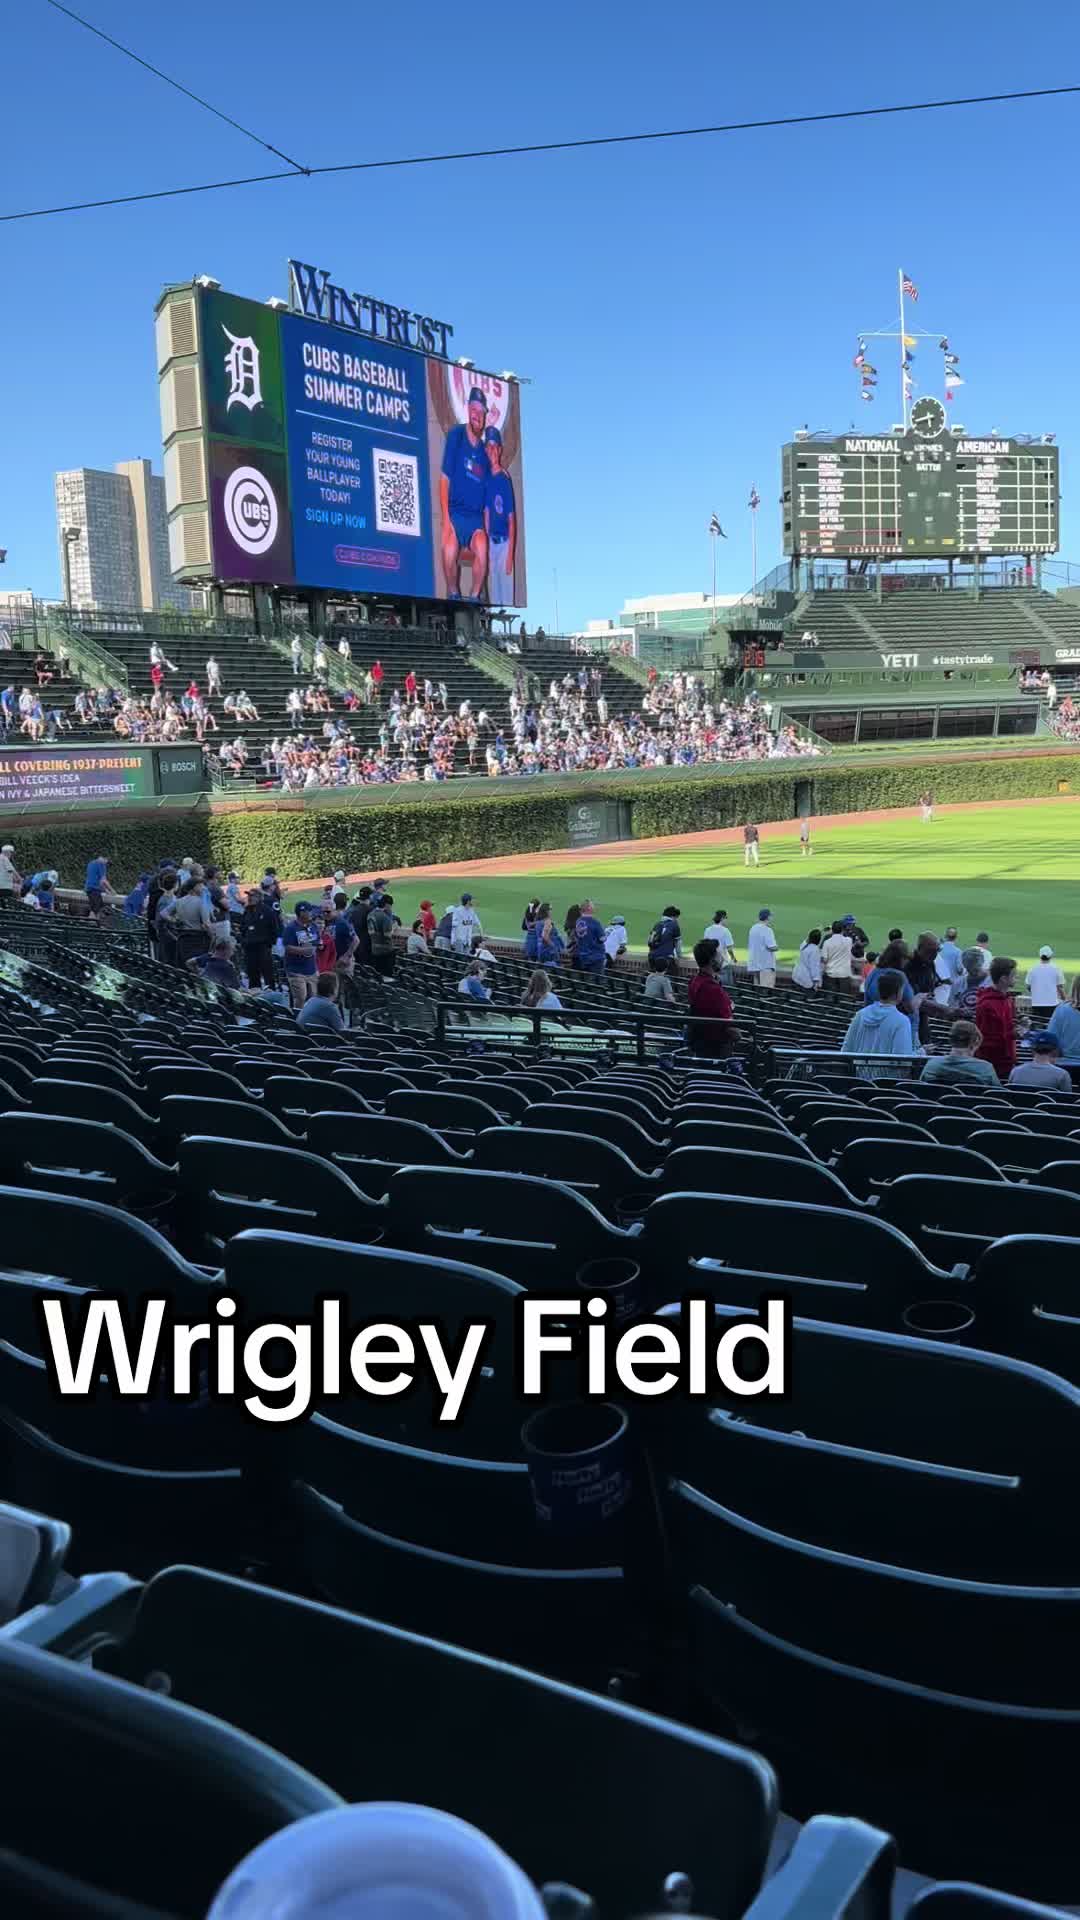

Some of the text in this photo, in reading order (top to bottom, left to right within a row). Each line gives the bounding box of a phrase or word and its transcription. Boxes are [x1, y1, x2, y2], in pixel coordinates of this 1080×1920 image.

[288, 259, 453, 359] WINTRUST
[303, 342, 409, 394] CUBS BASEBALL
[304, 374, 410, 423] SUMMER CAMPS
[312, 431, 353, 453] REGISTER
[845, 439, 901, 452] NATIONAL
[956, 438, 1010, 453] AMERICAN
[305, 448, 361, 471] YOUR YOUNG
[307, 467, 361, 488] BALLPLAYER
[305, 508, 366, 529] SIGN UP NOW
[880, 653, 920, 668] YETI
[939, 653, 994, 665] tastytrade
[14, 760, 71, 773] COVERING
[171, 761, 197, 773] BOSCH
[60, 772, 81, 784] IDEA
[8, 789, 22, 799] IVY
[24, 789, 31, 798] &
[32, 786, 79, 798] JAPANESE
[80, 782, 136, 796] BITTERSWEET
